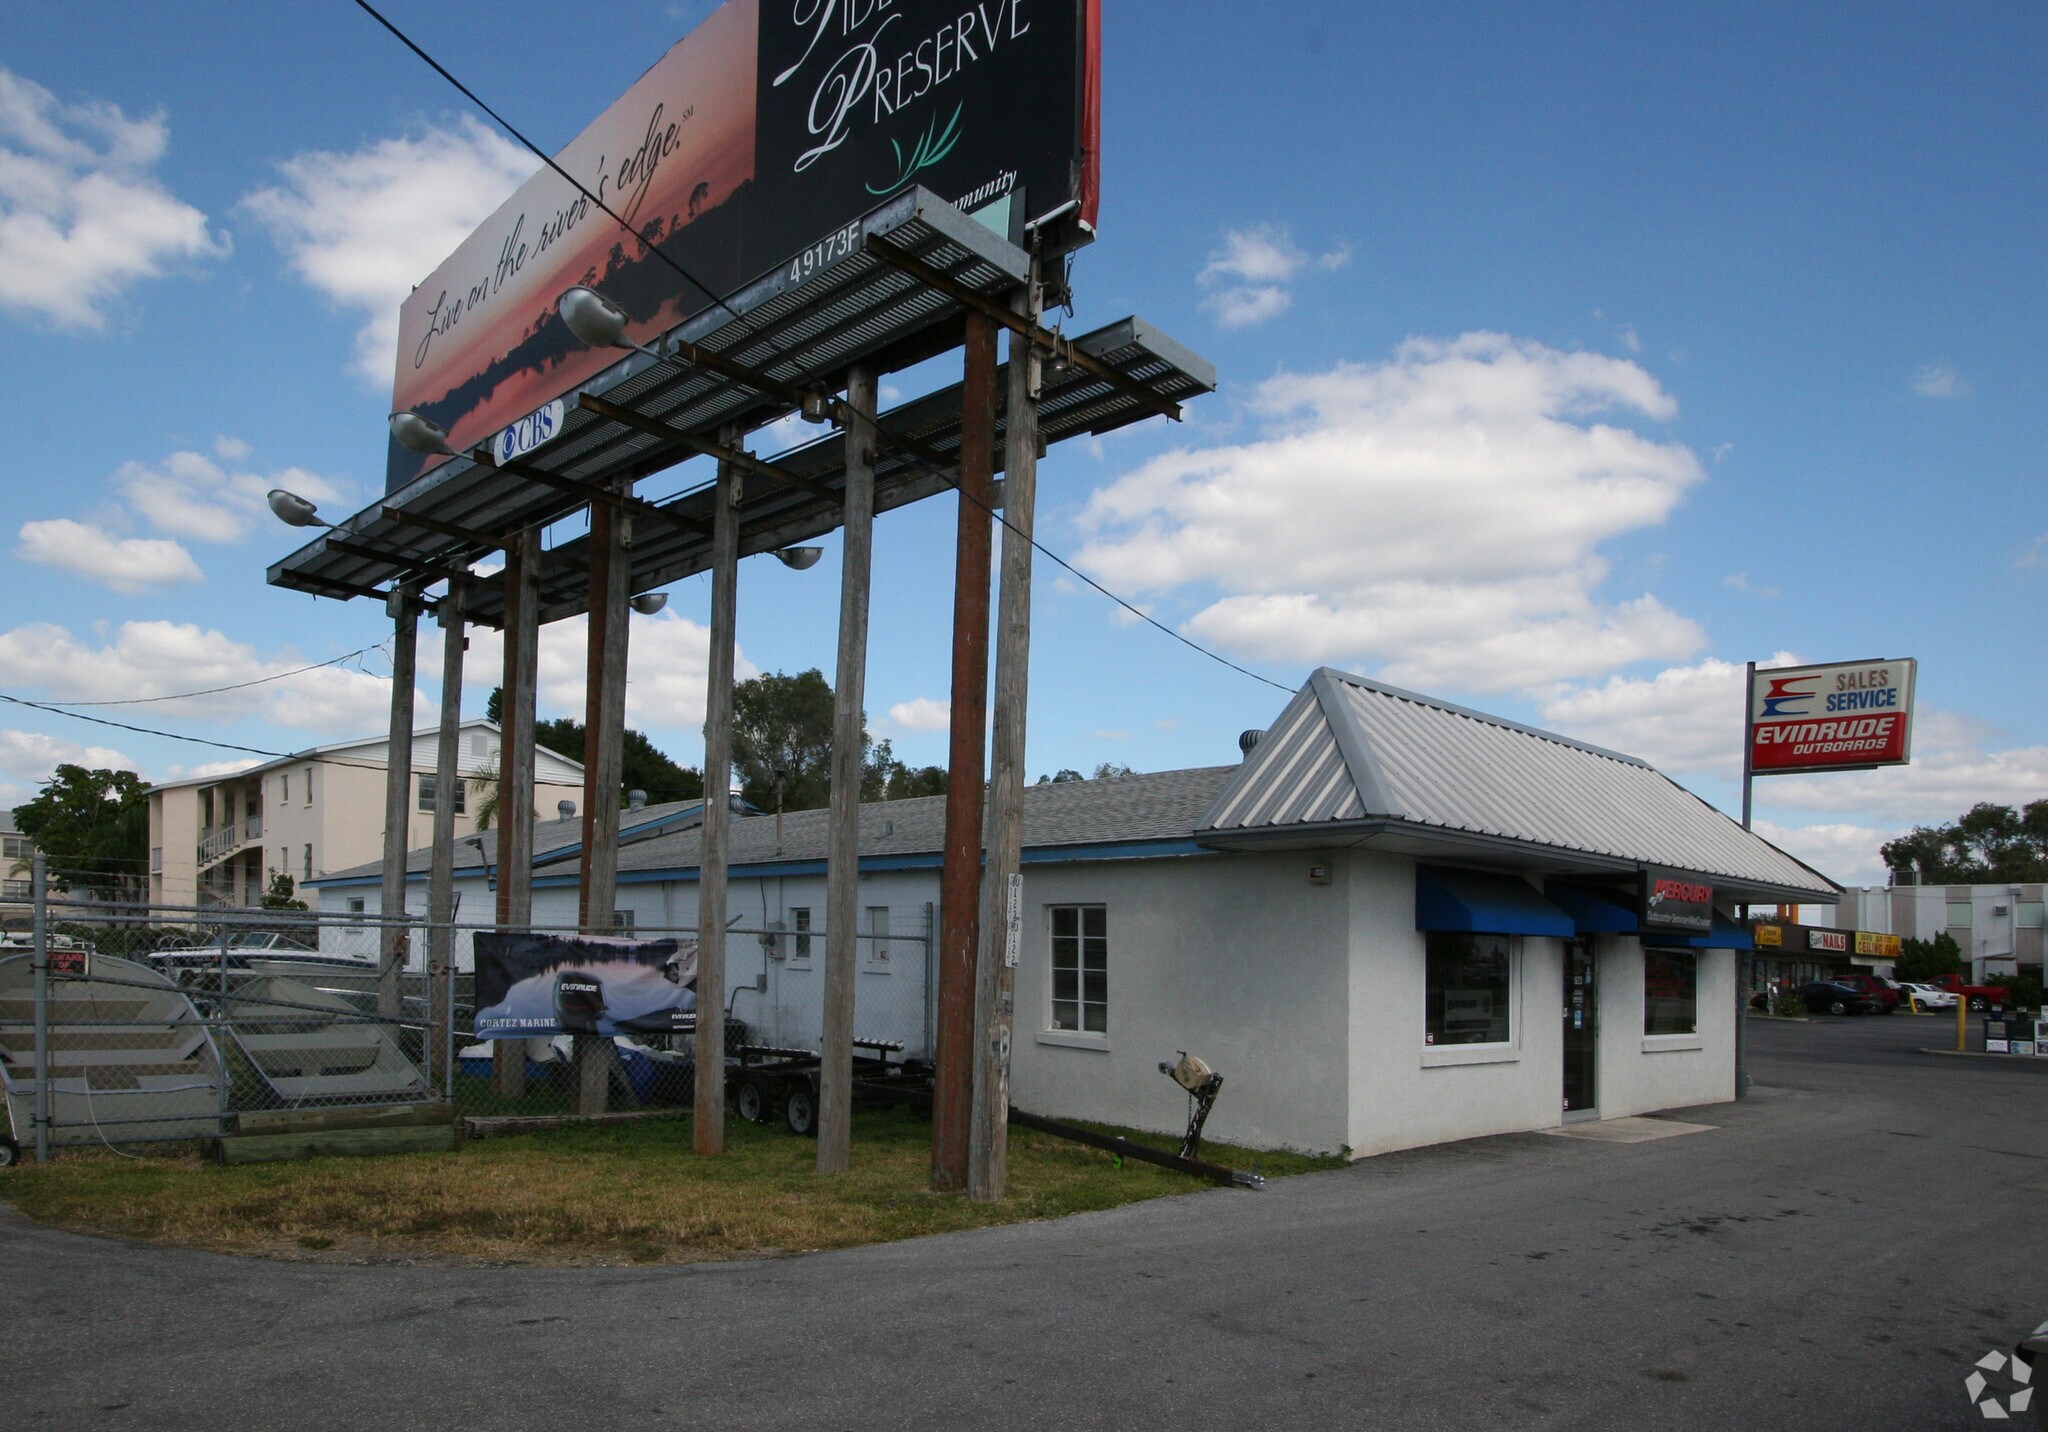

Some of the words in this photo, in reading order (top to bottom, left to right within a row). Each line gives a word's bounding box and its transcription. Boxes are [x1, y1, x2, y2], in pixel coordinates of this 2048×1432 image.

[794, 0, 1031, 172] PRESERVE
[415, 291, 462, 368] Live
[467, 276, 489, 311] on
[494, 214, 529, 294] the
[531, 155, 609, 260] river's
[617, 102, 681, 232] edge.
[790, 220, 860, 284] 49173F
[518, 404, 553, 452] CBS
[1836, 669, 1888, 692] SALES
[1826, 688, 1897, 712] SERVICE
[1756, 717, 1895, 744] EVINRUDE
[1793, 738, 1887, 755] OUTBOARDS
[1654, 879, 1712, 904] MERCURY
[1823, 934, 1844, 949] NAILS
[1858, 941, 1882, 954] CEILING
[1885, 943, 1899, 956] FANS
[561, 983, 598, 992] EVINRUDE
[480, 1018, 517, 1028] CORTEZ
[520, 1018, 556, 1028] MARINE
